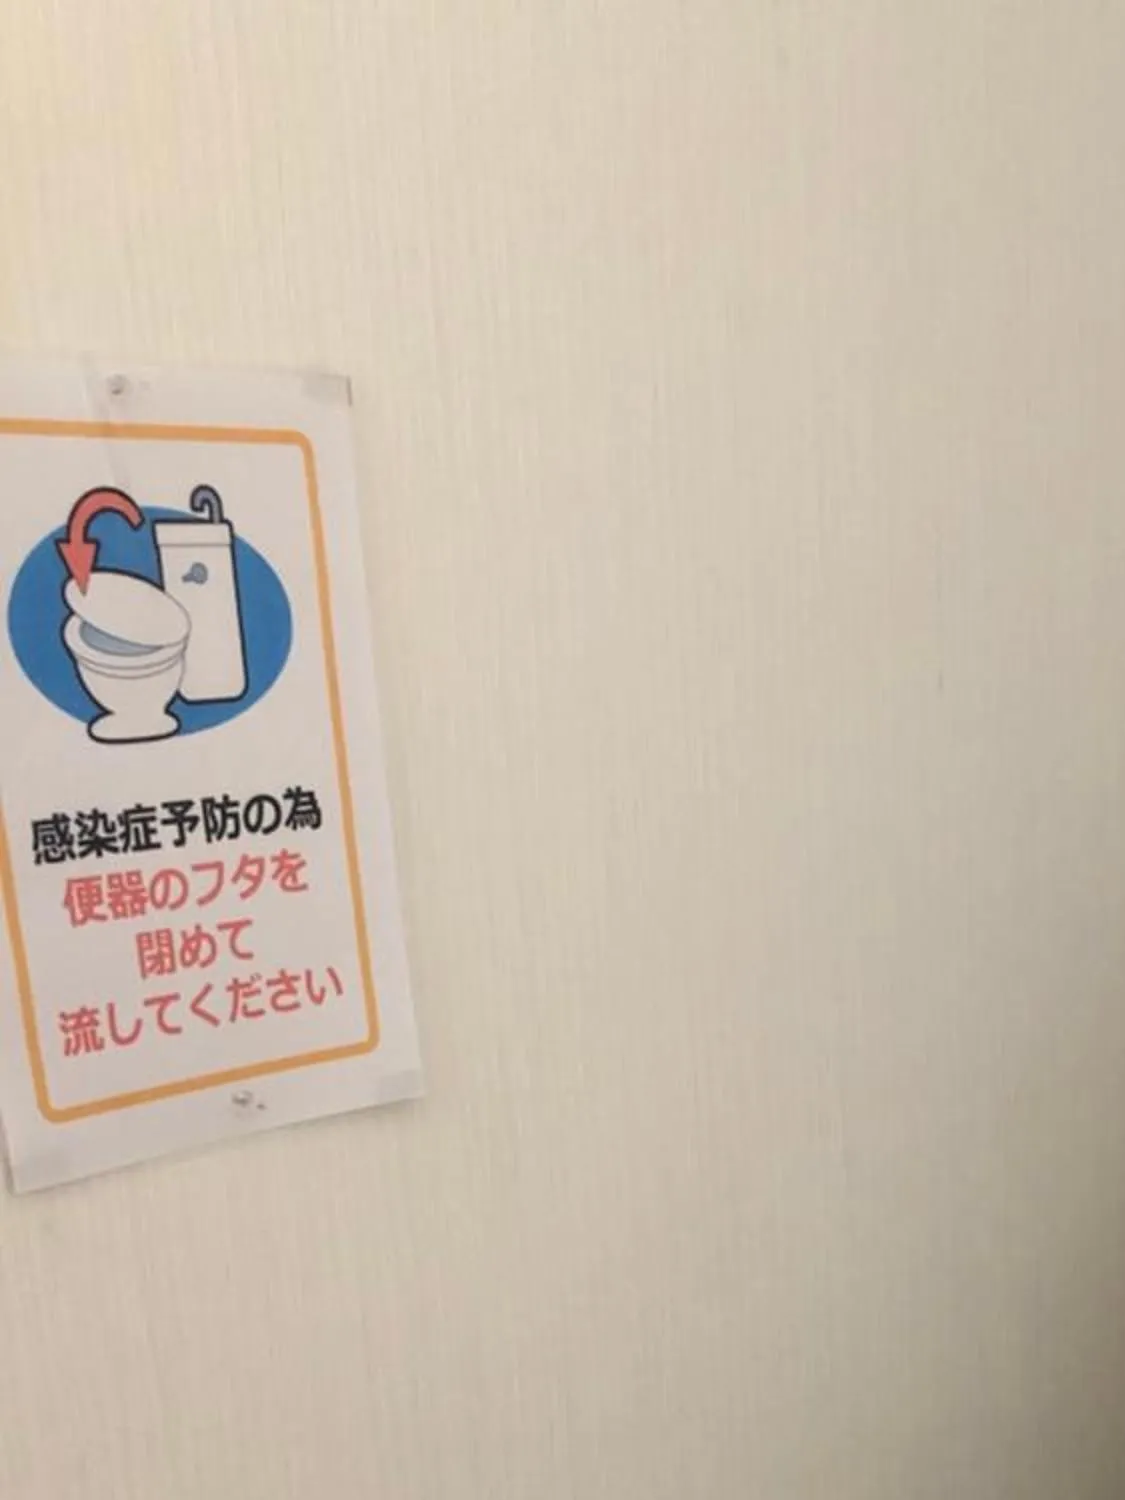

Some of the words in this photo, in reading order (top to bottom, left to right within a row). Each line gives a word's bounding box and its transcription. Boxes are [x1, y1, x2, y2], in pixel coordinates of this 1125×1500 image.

[31, 786, 322, 865] 感染症予防の為
[62, 849, 309, 927] 便器のフタを
[135, 919, 254, 979] 閉めて
[58, 966, 343, 1056] 流してください
